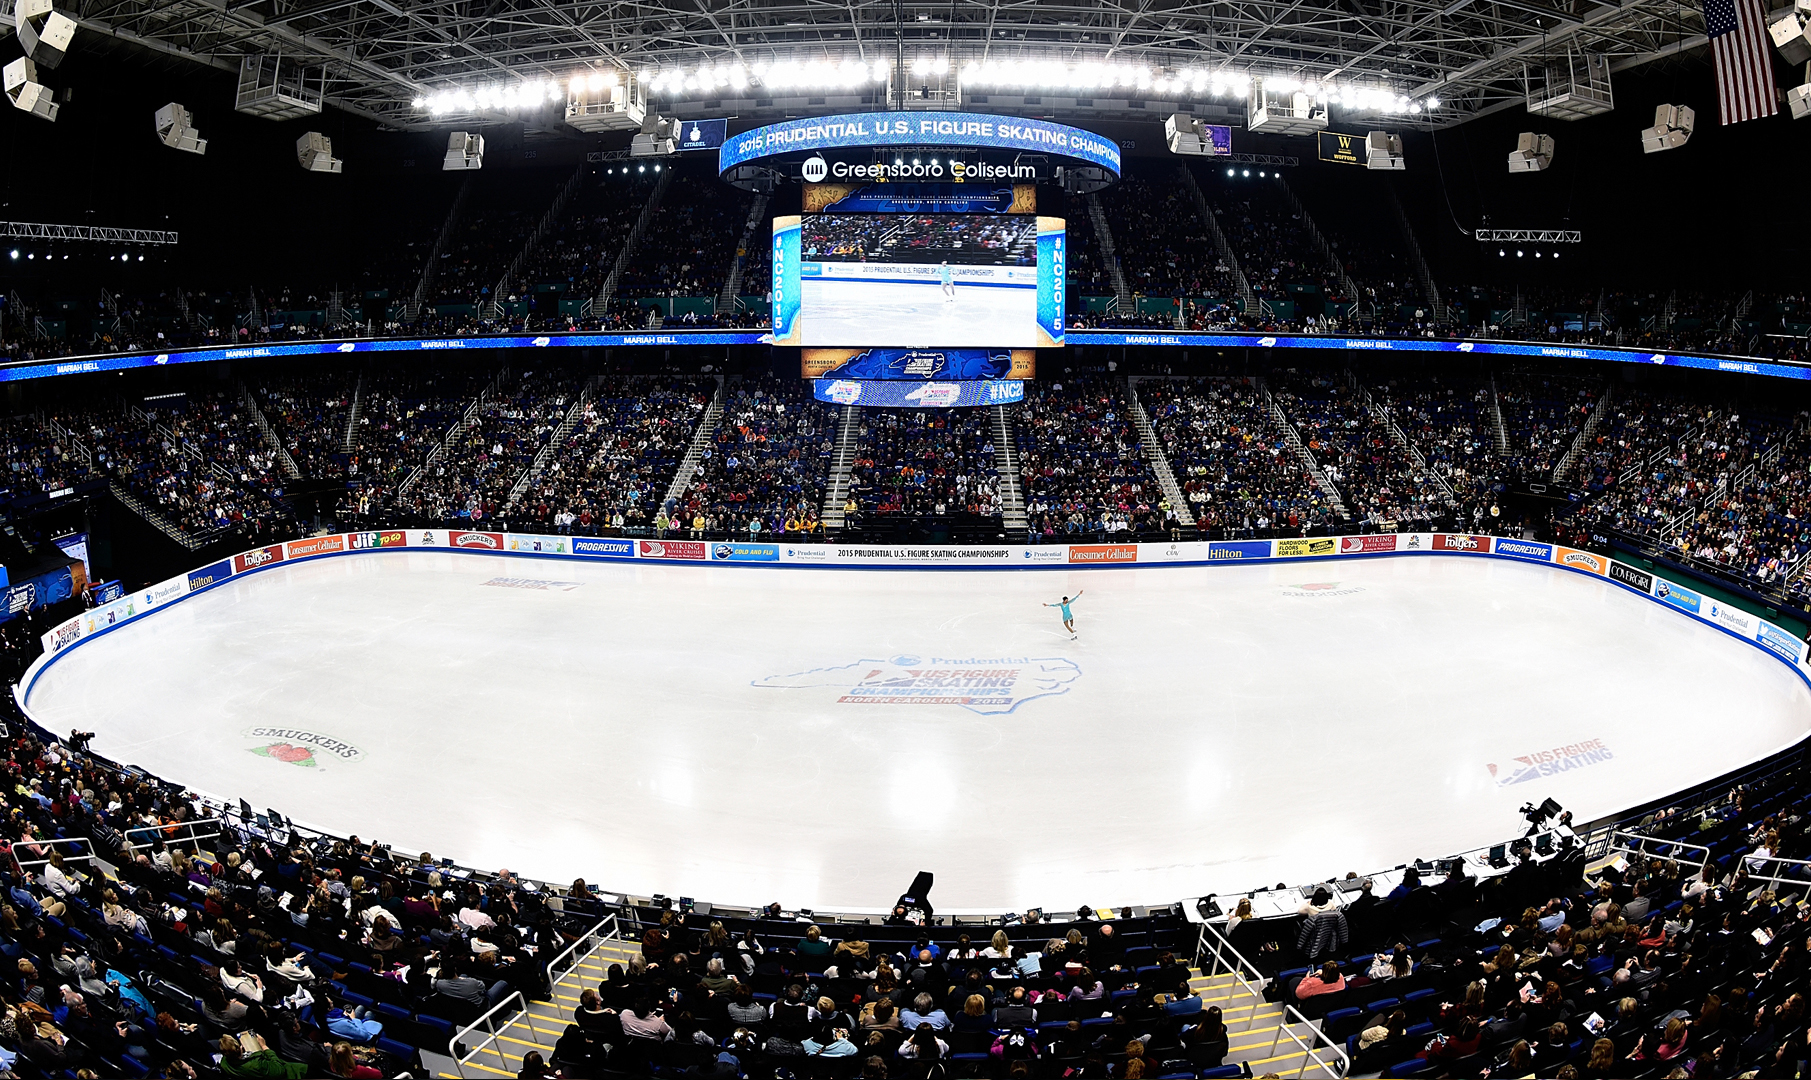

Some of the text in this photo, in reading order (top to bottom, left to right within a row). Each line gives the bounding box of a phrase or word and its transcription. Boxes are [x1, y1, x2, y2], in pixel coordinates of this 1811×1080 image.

[739, 136, 763, 154] 2015
[766, 123, 869, 147] PRUDENTIAL
[876, 120, 914, 135] U.S.
[920, 120, 993, 136] FIGURE
[997, 124, 1068, 146] SKATING
[1338, 136, 1352, 149] W
[1333, 153, 1357, 162] WOFFORD
[832, 160, 1036, 179] Greensboro Coliseum
[876, 184, 970, 213] 2015
[774, 236, 784, 329] #NC2015
[1053, 237, 1063, 330] #NC2015
[448, 340, 465, 348] BELL
[657, 336, 677, 344] BELL
[1126, 336, 1159, 344] MARIAH
[1346, 340, 1393, 349] MARIAH BELL
[225, 348, 270, 358] MARIAH BELL
[1542, 347, 1589, 358] MARIAH BELL
[57, 363, 99, 374] MARIAH BELL
[1718, 361, 1759, 373] MARIAH BELL
[352, 532, 402, 549] Jif TO GO
[575, 541, 630, 553] PROGRESSIVE
[1444, 536, 1478, 551] Folgers
[288, 539, 342, 556] Consumer Cellular
[838, 549, 1009, 558] 2015 PRUDENTIAL U.S. FIGURE SKATING CHAMPIONSHIPS
[1069, 547, 1136, 560] Consumer Cellular
[1209, 548, 1242, 559] Hilton
[1498, 542, 1549, 557] PROGRESSIVE
[243, 551, 273, 567] Folgers
[189, 575, 213, 590] Hilton
[1611, 565, 1649, 590] COVERGIRL
[154, 582, 180, 599] Prudential
[1720, 609, 1749, 629] Prudential
[60, 628, 81, 648] SKATING
[930, 657, 1030, 665] Prudential
[922, 669, 1021, 678] US FIGURE
[914, 677, 1017, 688] SKATING
[849, 687, 1012, 696] CHAMPIONSHIPS
[843, 696, 895, 704] NORTH
[252, 727, 359, 759] SMUCKER'S
[1531, 738, 1605, 764] US FIGURE
[1538, 747, 1614, 777] SKATING
